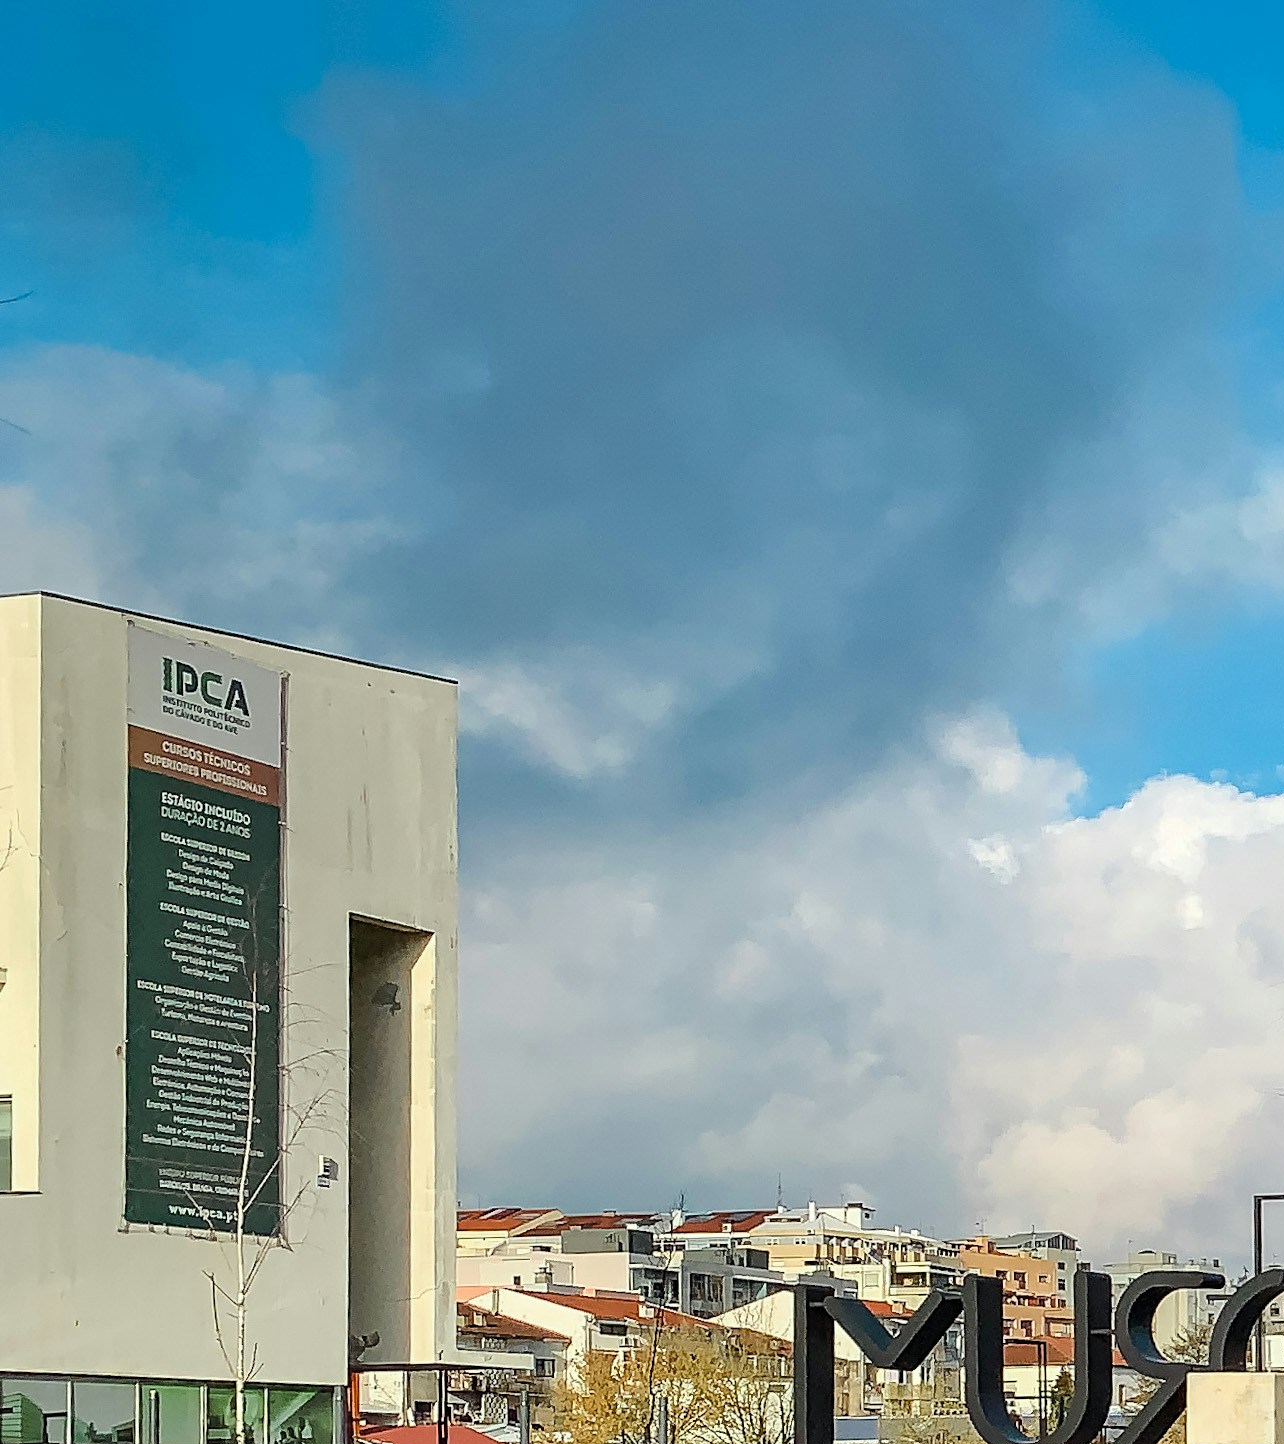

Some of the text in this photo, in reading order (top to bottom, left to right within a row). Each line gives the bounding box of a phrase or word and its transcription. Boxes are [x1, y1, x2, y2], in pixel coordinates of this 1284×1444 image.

[163, 657, 250, 717] IPCA
[162, 695, 251, 728] INSTITUTO POLITÉCNICO
[162, 705, 174, 715] DO
[175, 707, 205, 725] CÁVADO
[213, 720, 223, 730] DO
[225, 725, 238, 735] AVE
[143, 752, 268, 796] SUPERIORES PROFISSIONAIS
[162, 740, 251, 776] CURSOS TÉCNICOS
[161, 792, 251, 825] ESTÁGIO INCLUÍDO
[161, 806, 251, 839] DURAÇÃO DE 2 ANOS
[168, 1204, 239, 1224] www.ipca.pt
